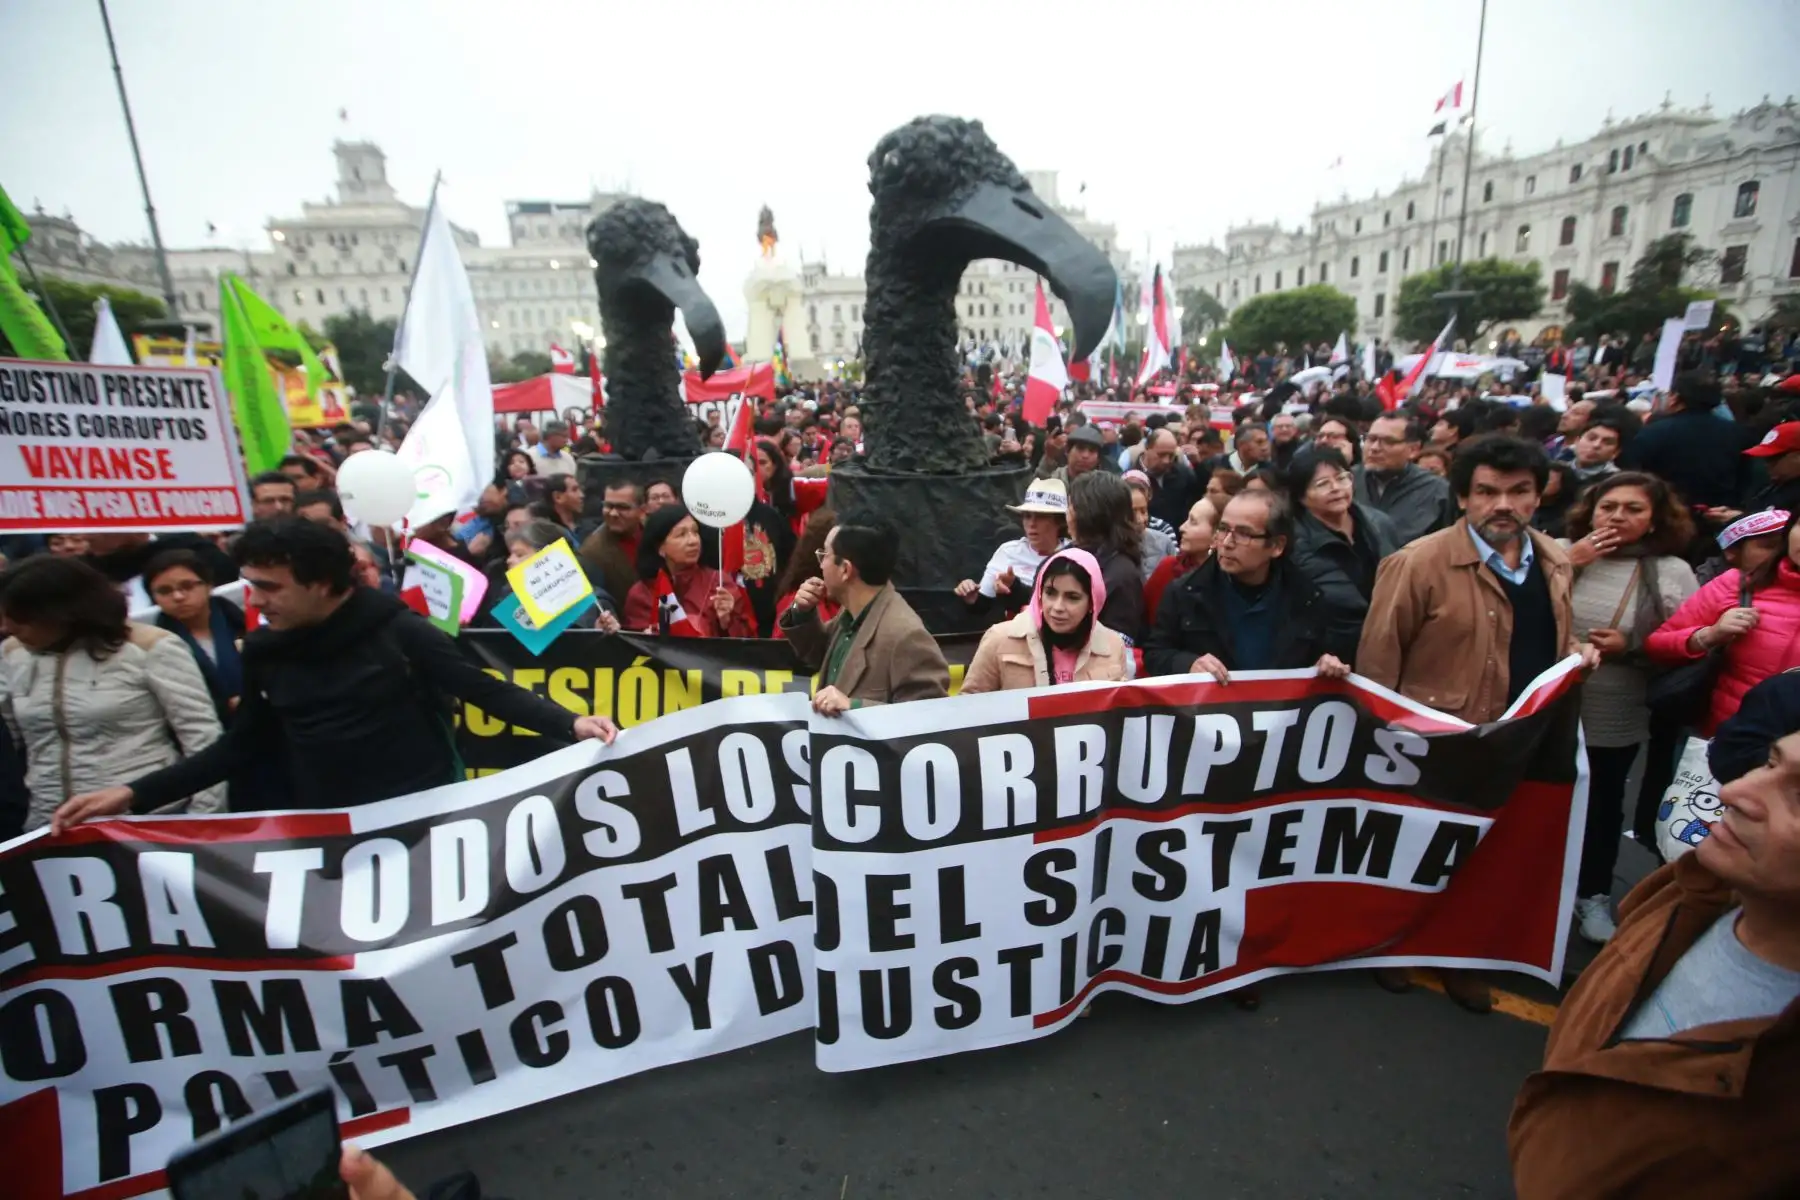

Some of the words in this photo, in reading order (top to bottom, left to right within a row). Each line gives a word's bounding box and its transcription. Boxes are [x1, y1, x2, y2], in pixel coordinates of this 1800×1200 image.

[102, 374, 210, 409] PRESENTE
[76, 413, 206, 440] CORRUPTOS
[18, 445, 176, 480] VAYANSE
[83, 490, 139, 518] PISA
[135, 490, 161, 518] EL
[158, 489, 239, 517] PONCHO
[697, 501, 709, 509] NO
[253, 769, 642, 950] TODOS
[820, 701, 1429, 844] CORRUPTOS
[451, 844, 813, 1010] TOTAL
[1023, 806, 1482, 927] SISTEMA
[666, 951, 714, 1032] Y
[816, 907, 1222, 1046] JUSTICIA
